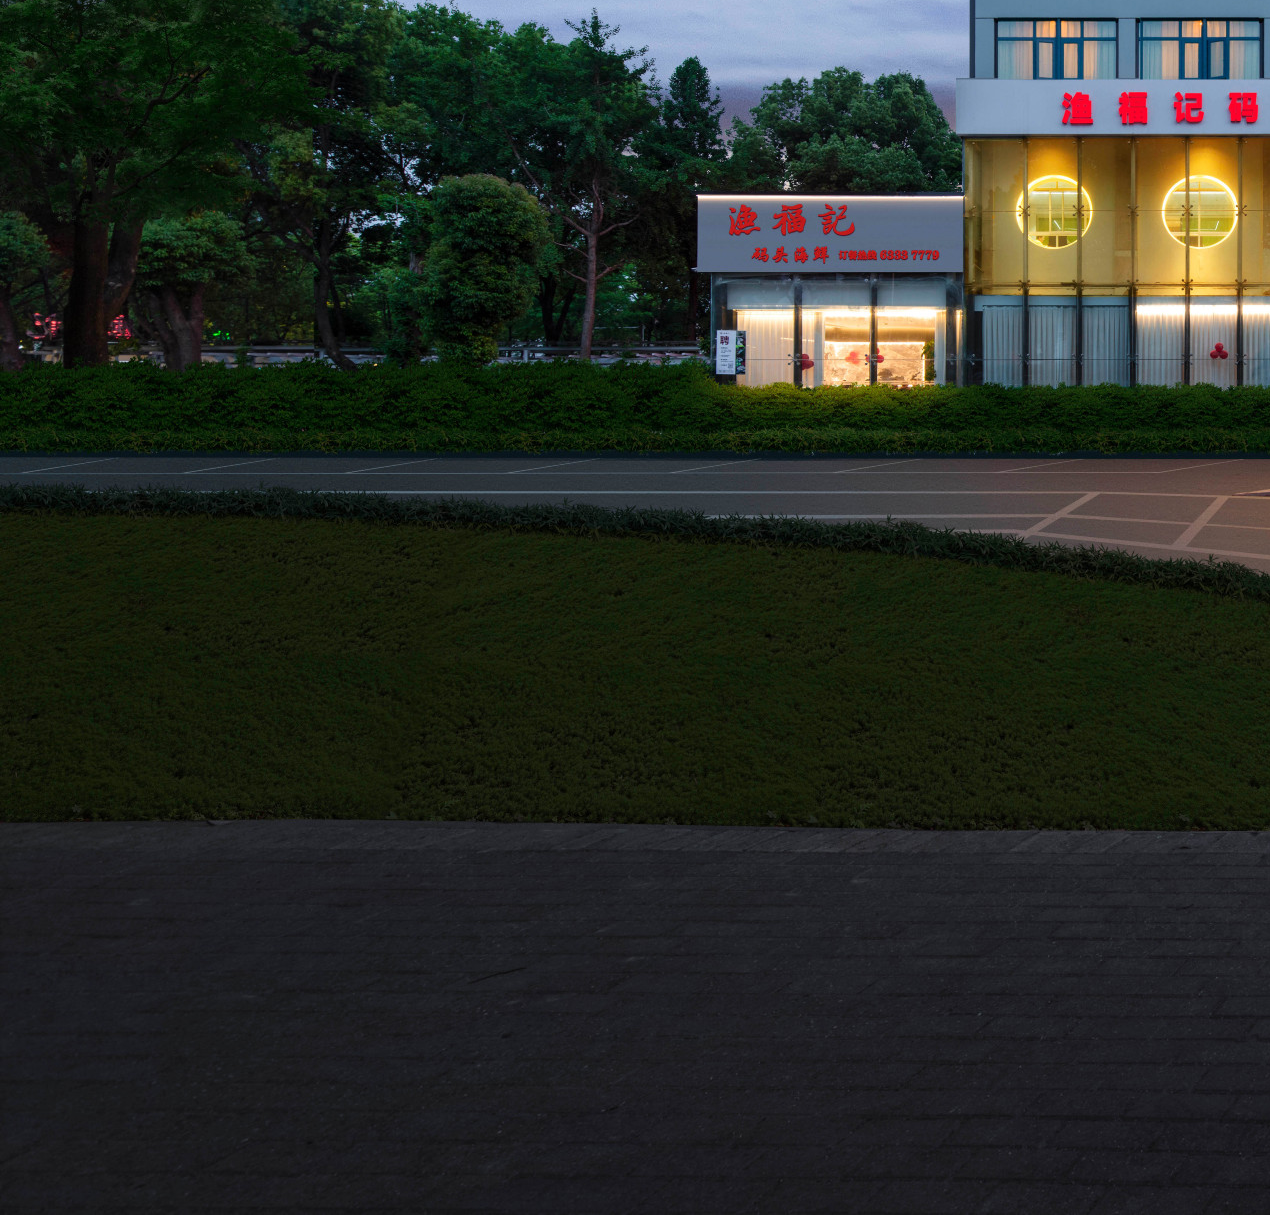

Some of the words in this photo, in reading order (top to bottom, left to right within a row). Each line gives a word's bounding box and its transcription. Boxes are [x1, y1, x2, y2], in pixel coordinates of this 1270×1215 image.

[751, 245, 829, 264] 码头海鲜
[879, 249, 909, 261] 6333
[910, 249, 940, 261] 7779
